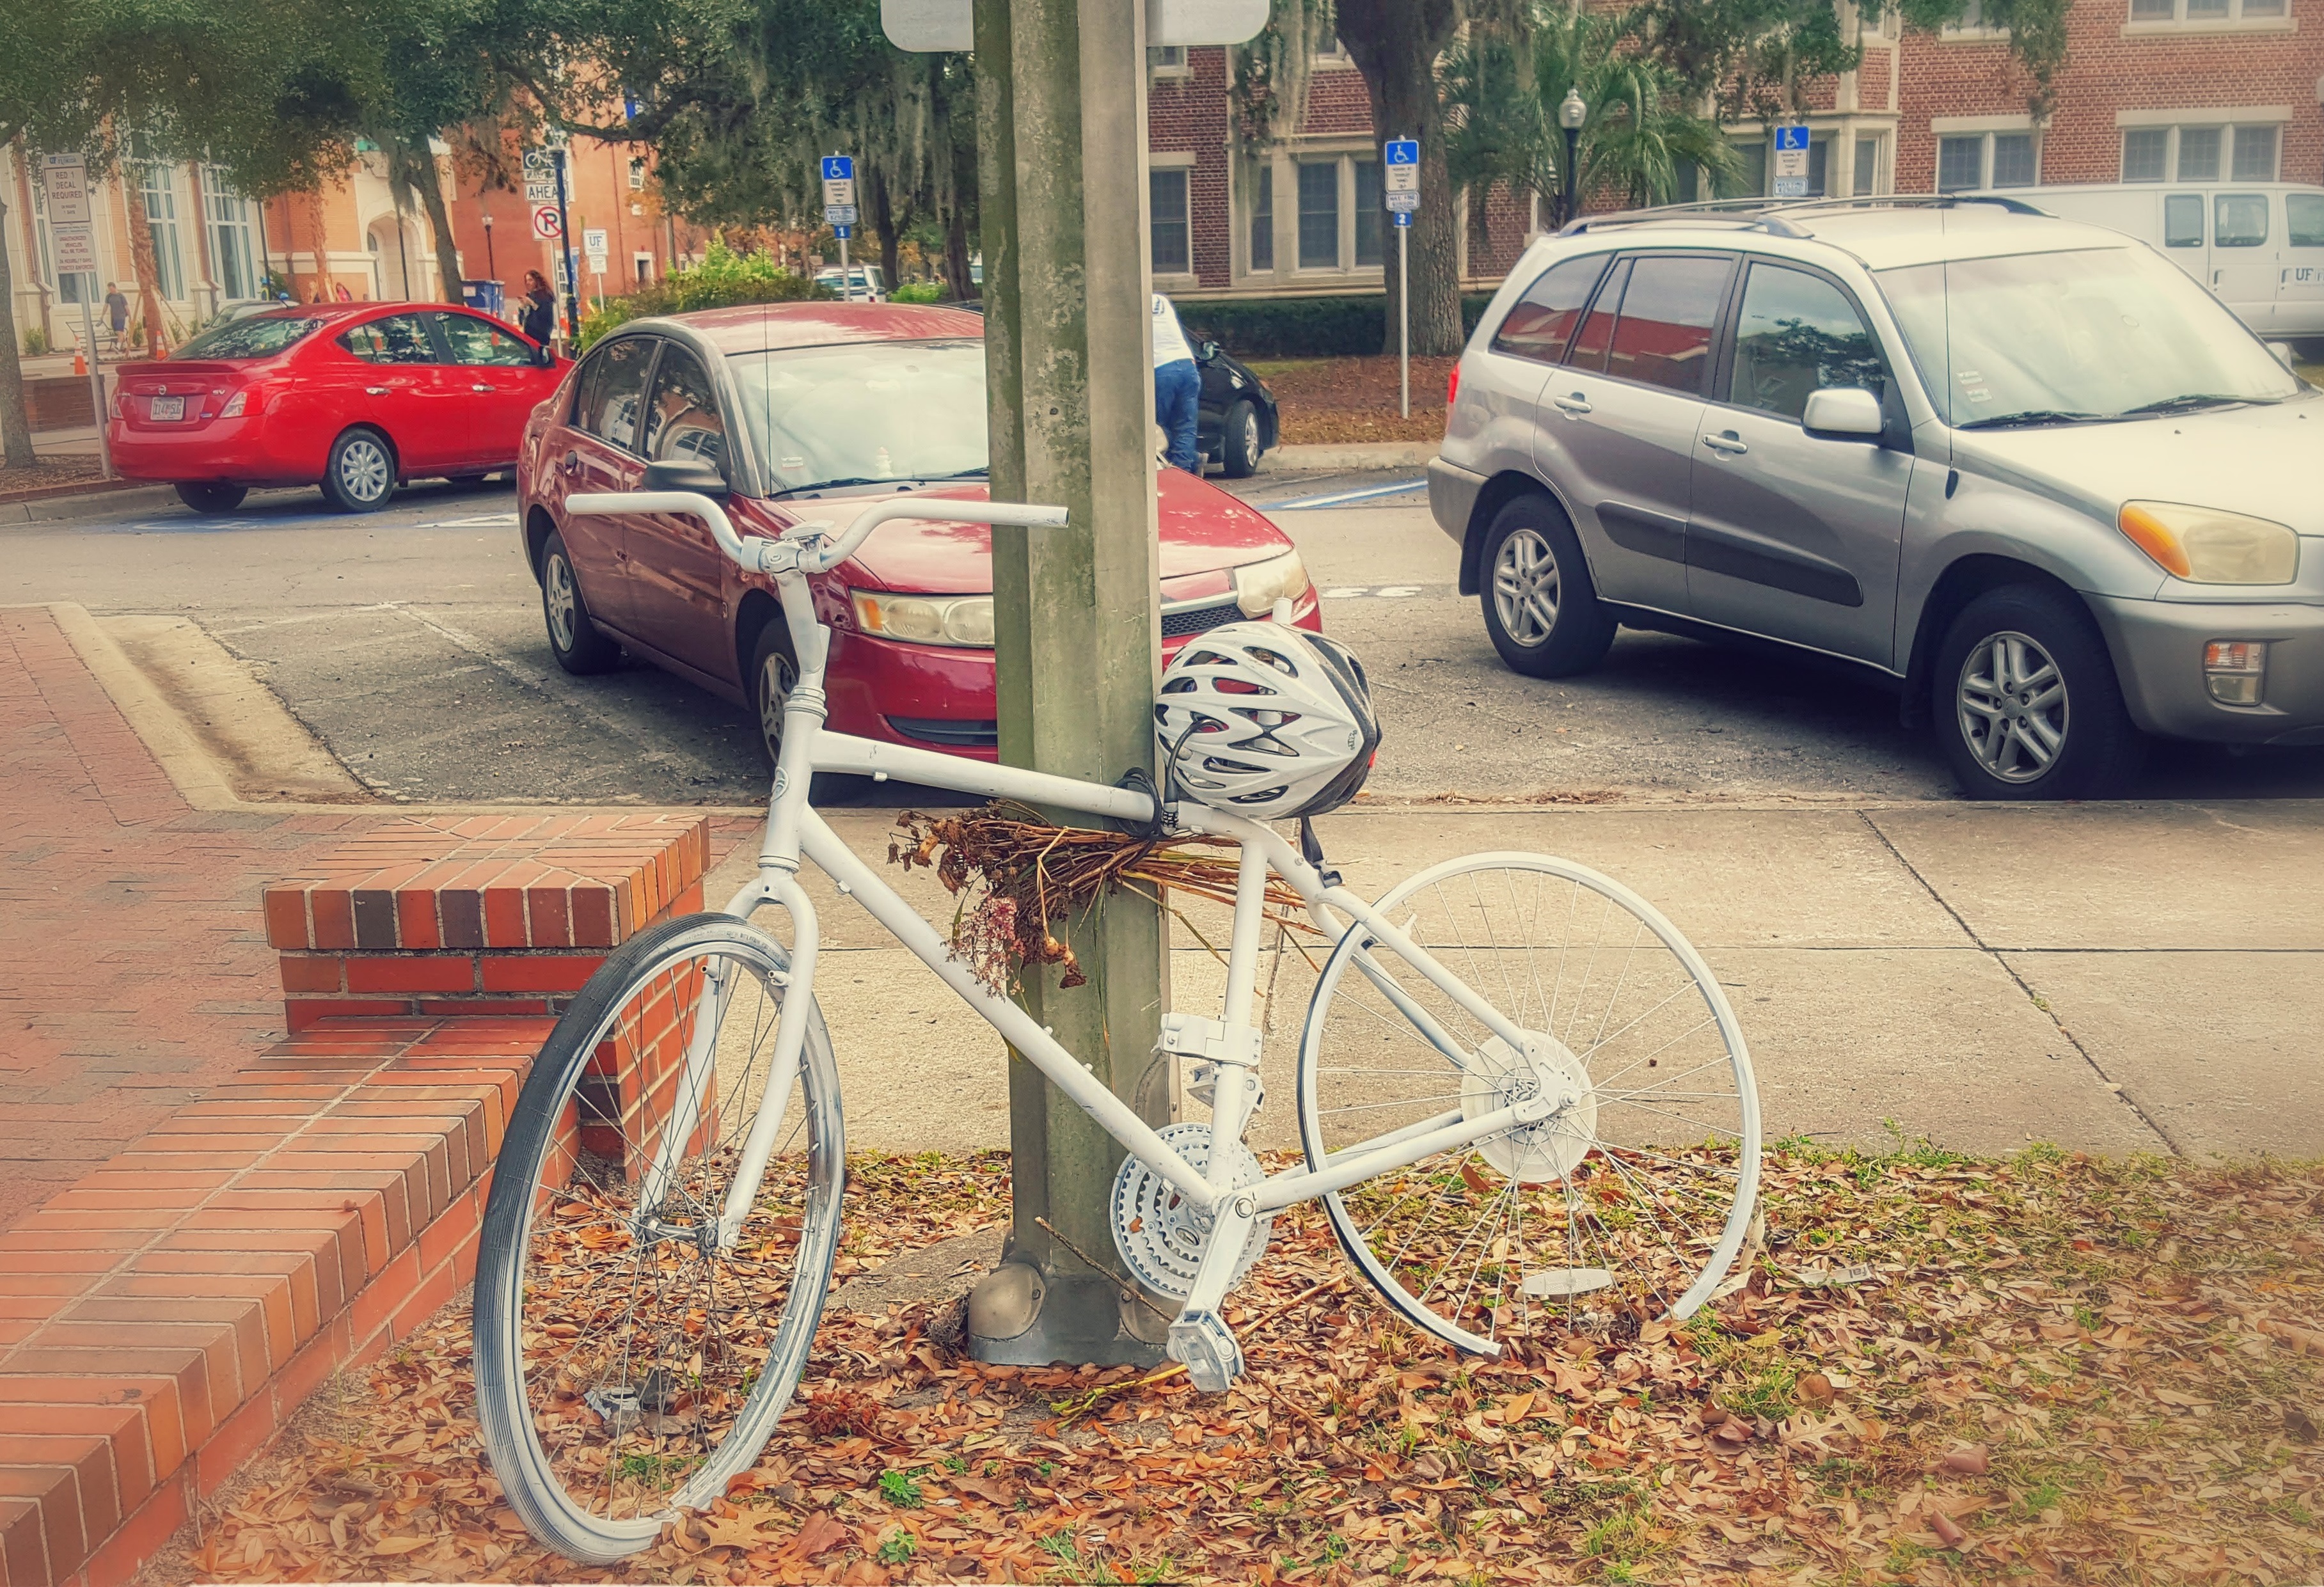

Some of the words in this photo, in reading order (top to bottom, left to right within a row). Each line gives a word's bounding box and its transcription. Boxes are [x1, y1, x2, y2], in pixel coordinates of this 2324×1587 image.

[52, 191, 83, 199] REQUIRED
[529, 186, 558, 198] AHEA
[1399, 213, 1406, 224] 2
[839, 227, 844, 237] 1
[589, 236, 603, 246] UF
[2295, 268, 2314, 281] UF
